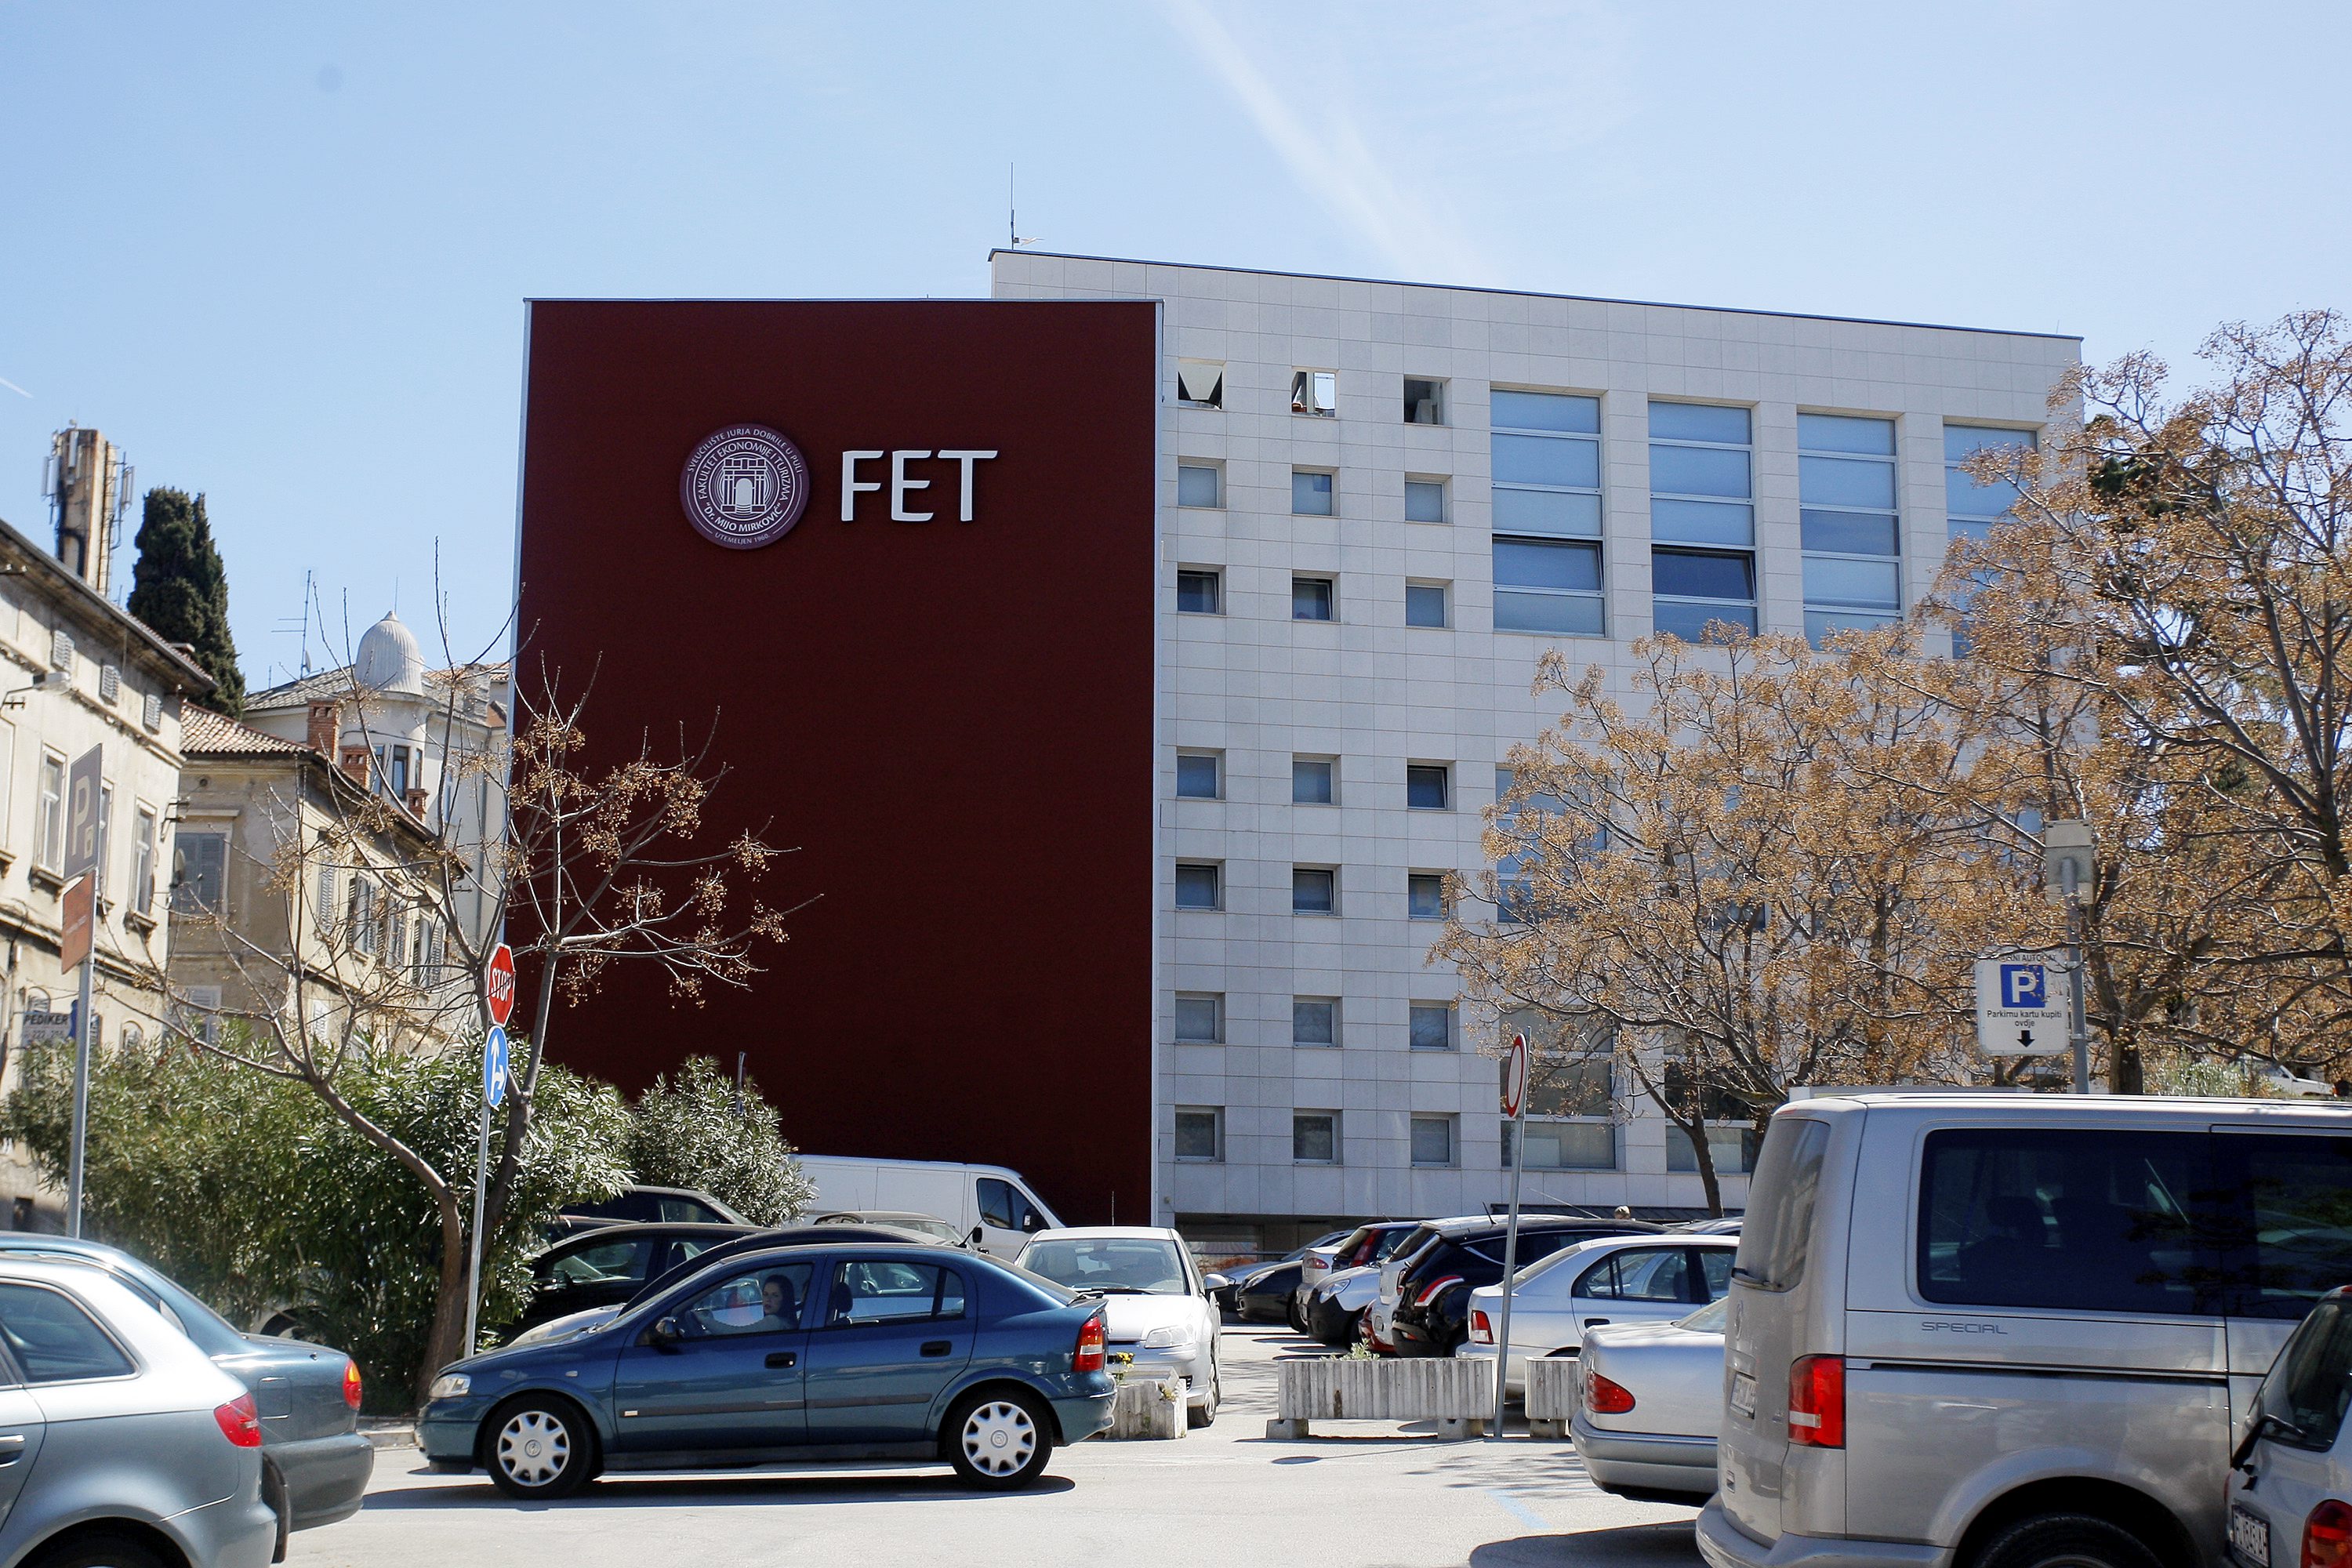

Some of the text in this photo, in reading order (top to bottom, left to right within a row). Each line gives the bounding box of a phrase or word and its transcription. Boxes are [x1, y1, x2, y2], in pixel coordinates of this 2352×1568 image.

[688, 433, 726, 473] SVEUČILIŠTE
[727, 428, 751, 438] JURJA
[753, 429, 786, 448] DOBRILE
[790, 456, 803, 473] PULI
[698, 453, 718, 499] FAKULTET
[717, 441, 773, 458] EKONOMIJE
[775, 456, 792, 501] TURIZMA
[841, 450, 998, 521] FET
[714, 517, 737, 531] MIJO
[715, 532, 752, 545] UTEMELJEN
[71, 775, 91, 855] P
[491, 967, 512, 1002] STOP
[2011, 971, 2037, 1004] P
[2015, 1019, 2035, 1028] ovdje
[2041, 1010, 2062, 1019] kupiti
[1922, 1321, 2009, 1334] SPECIAL
